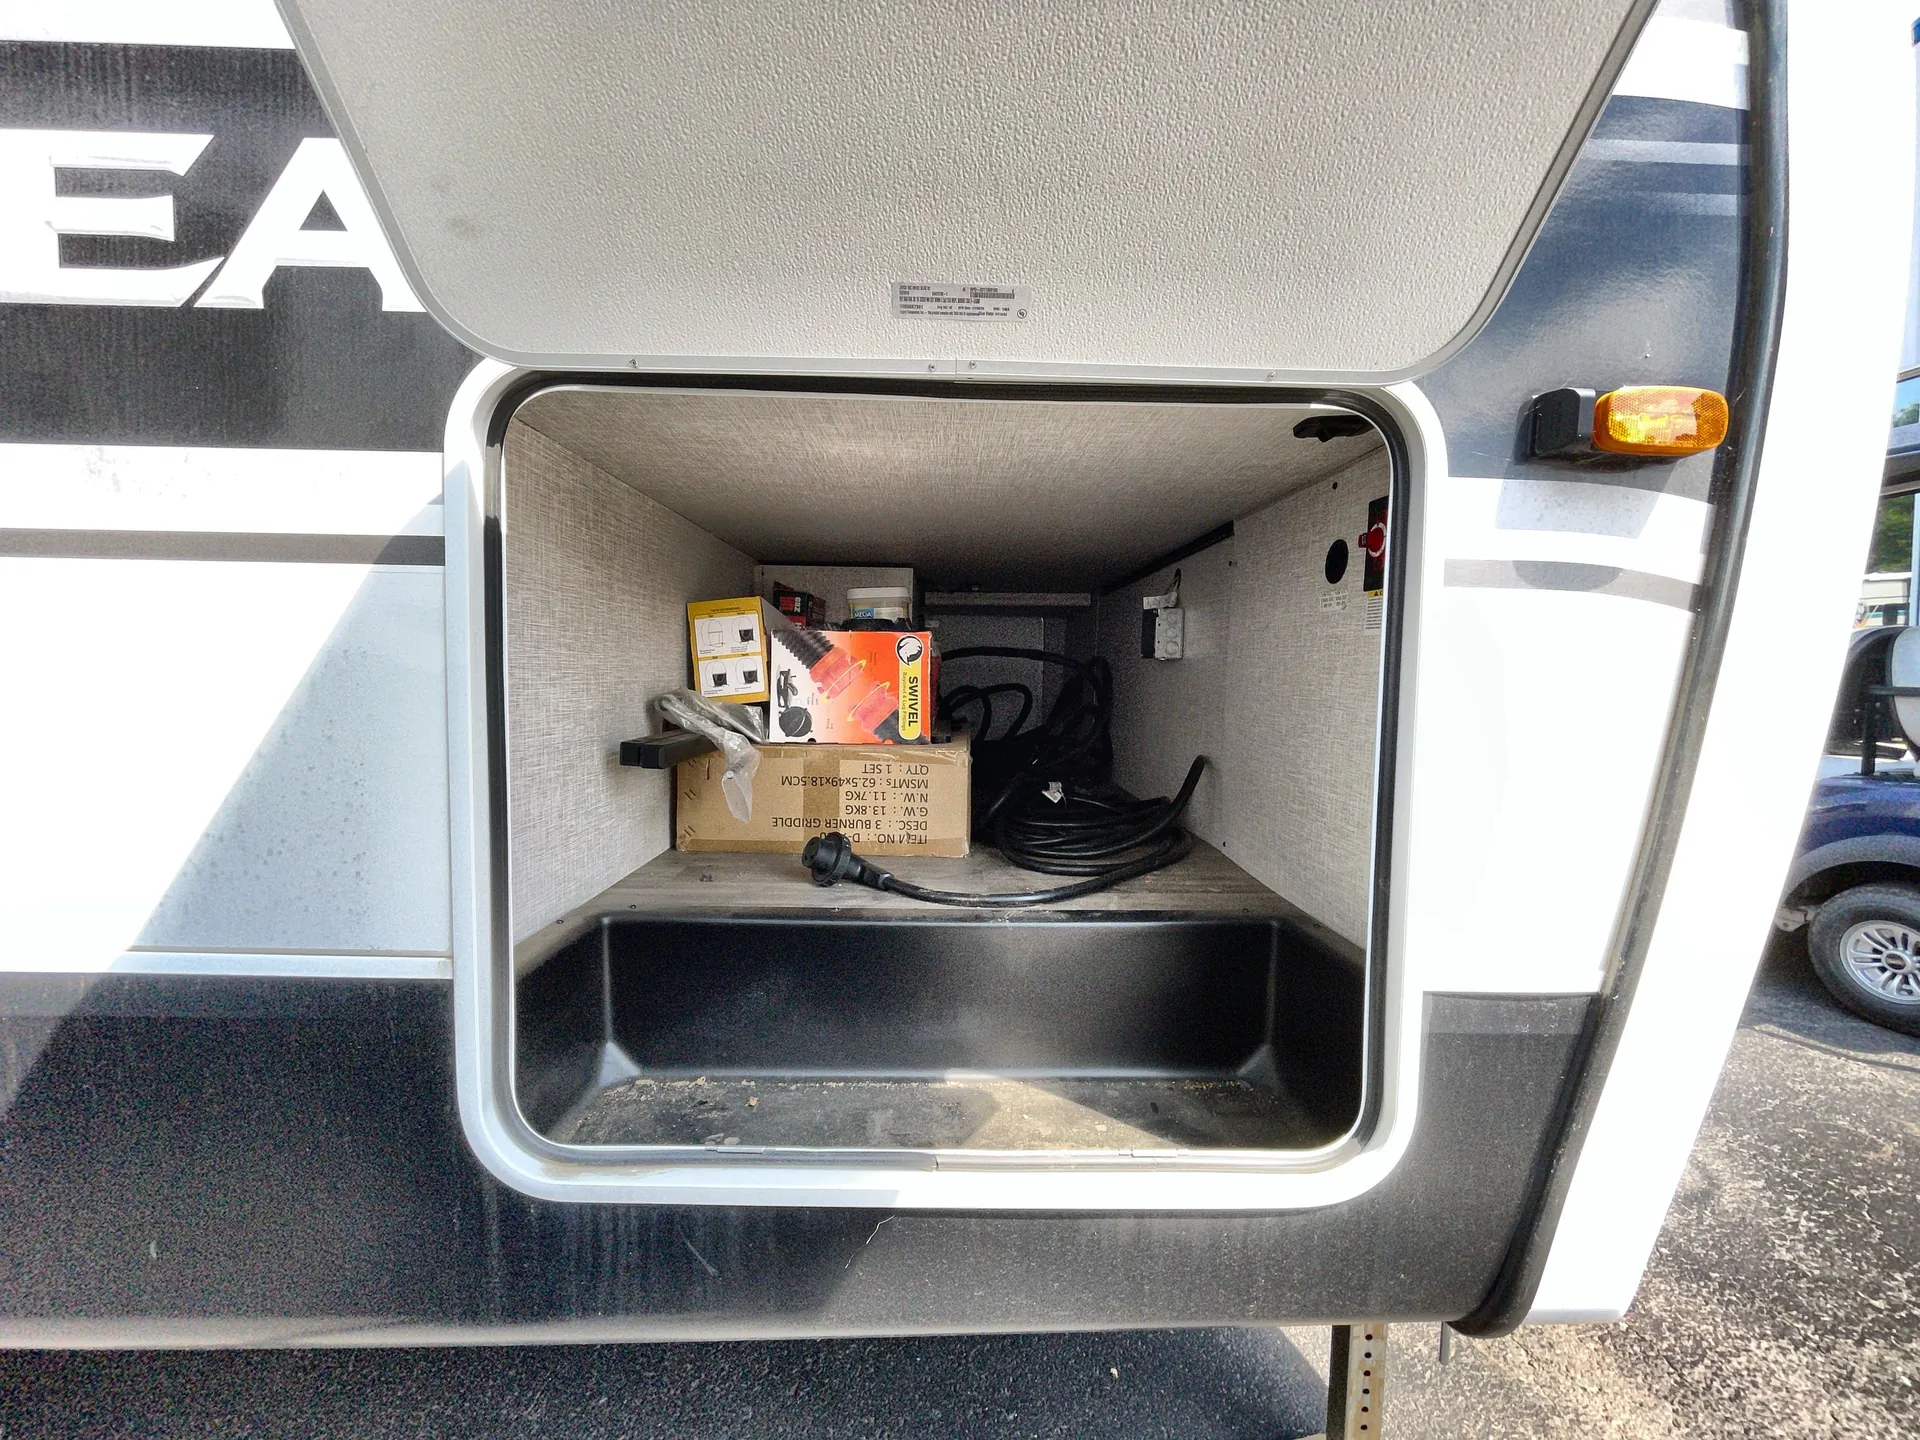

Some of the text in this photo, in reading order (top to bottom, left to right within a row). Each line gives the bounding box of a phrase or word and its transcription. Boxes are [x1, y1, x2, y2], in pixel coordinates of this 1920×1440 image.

[908, 676, 919, 727] SWIVEL
[862, 763, 882, 774] SET
[886, 764, 892, 774] 1
[906, 764, 929, 775] QTY
[781, 775, 876, 788] 62.5x49x18.5CM
[886, 778, 929, 789] MSMTs
[845, 790, 887, 801] 11.7KG
[900, 792, 929, 803] N.W.
[845, 804, 887, 816] 13.8KG
[900, 806, 929, 817] G.W.
[771, 816, 821, 828] GRIDDLE
[825, 818, 872, 830] BURNER
[875, 819, 882, 829] 3
[896, 820, 928, 831] DESC.
[874, 833, 895, 844] NO.
[898, 832, 927, 845] ITEM
